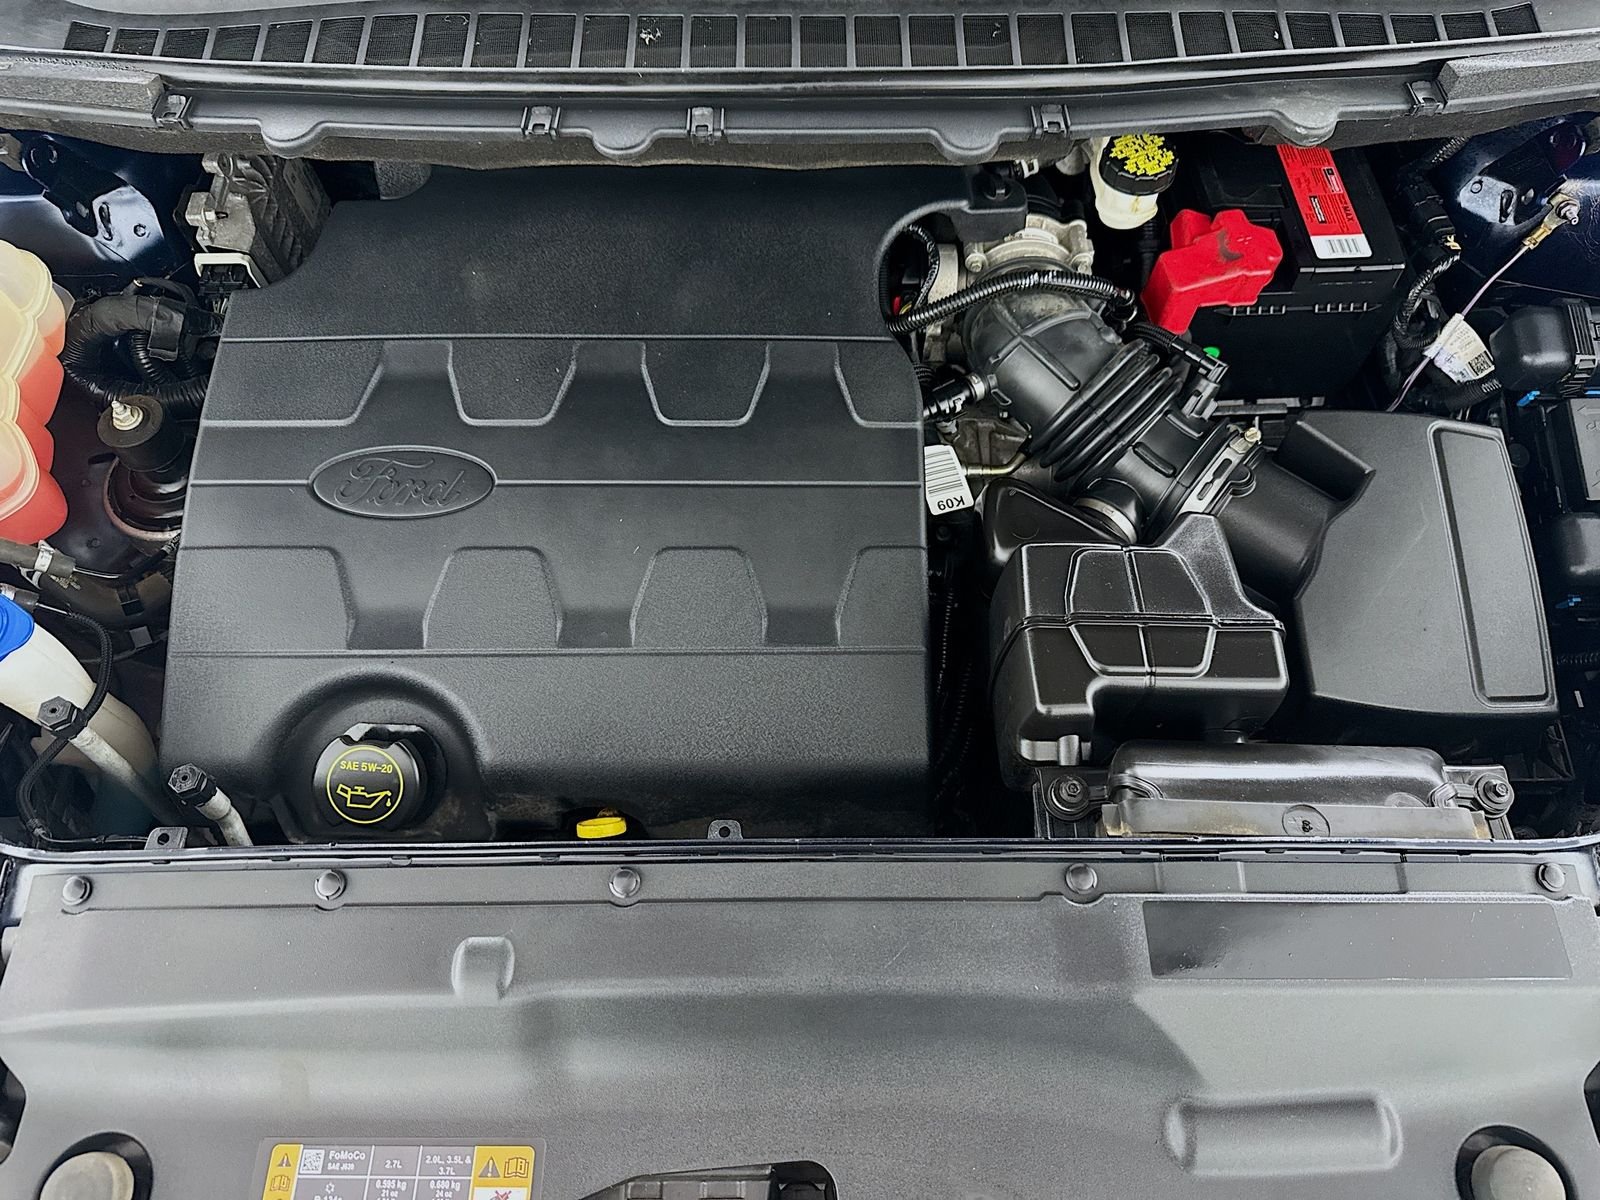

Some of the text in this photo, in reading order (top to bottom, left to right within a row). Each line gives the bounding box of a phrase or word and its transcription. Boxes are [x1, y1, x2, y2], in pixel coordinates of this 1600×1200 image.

[333, 457, 465, 507] Ford
[937, 495, 966, 511] K09
[340, 760, 393, 774] SAE 5W-20
[329, 1150, 366, 1160] FoMoCo
[446, 1155, 464, 1164] 3.5L
[384, 1159, 402, 1169] 2.7L
[438, 1166, 456, 1176] 3.7L
[396, 1179, 407, 1191] kg
[450, 1179, 461, 1191] kg
[381, 1189, 389, 1197] 21
